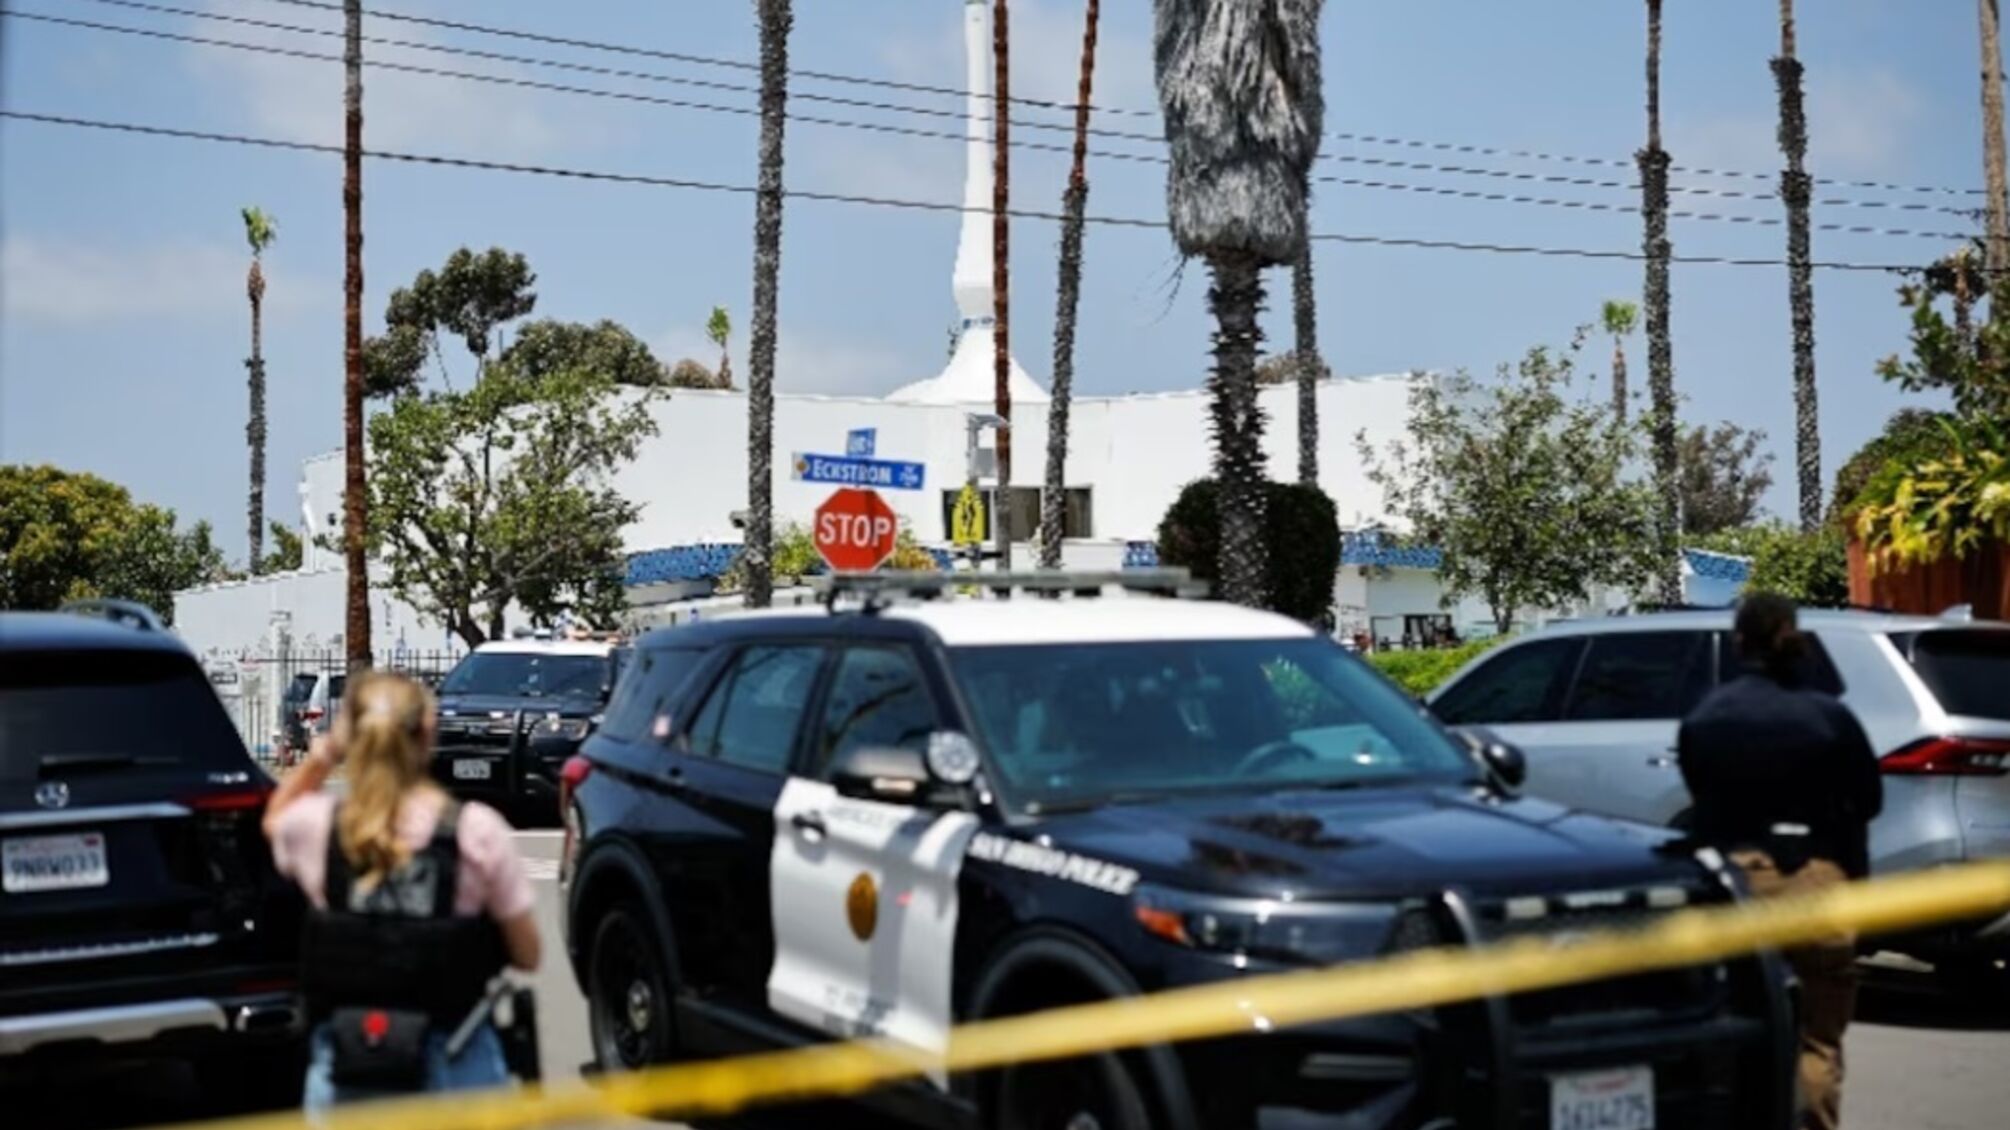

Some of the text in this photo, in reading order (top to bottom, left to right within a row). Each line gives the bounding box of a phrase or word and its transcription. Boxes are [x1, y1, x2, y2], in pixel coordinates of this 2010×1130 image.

[819, 512, 892, 548] STOP
[1002, 840, 1067, 876] DIEGO
[1059, 853, 1141, 896] POLICE
